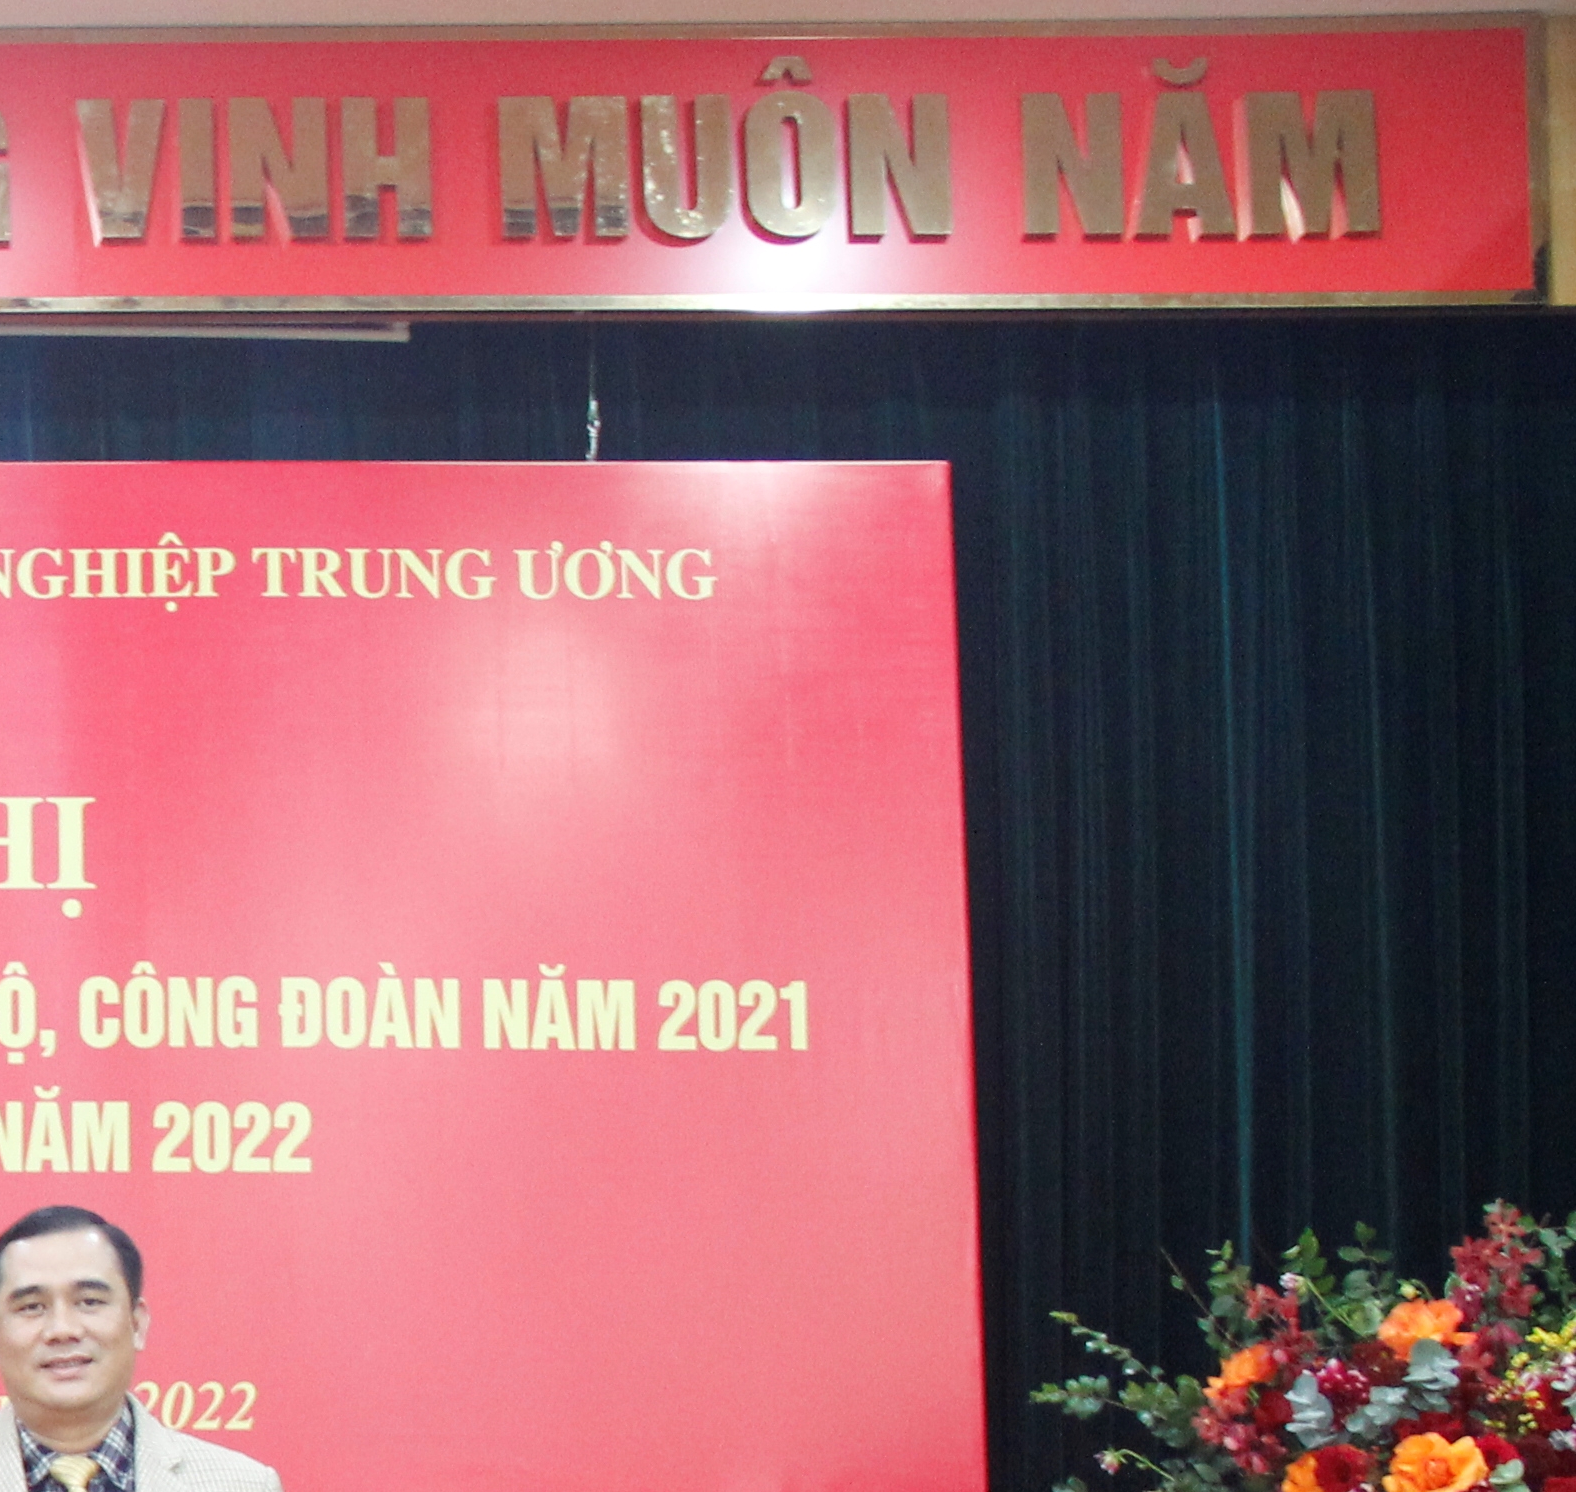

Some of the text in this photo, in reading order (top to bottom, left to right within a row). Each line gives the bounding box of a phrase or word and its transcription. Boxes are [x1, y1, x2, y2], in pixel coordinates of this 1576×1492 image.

[73, 96, 434, 248] VINH
[497, 54, 952, 243] MUÔN
[1019, 55, 1384, 242] NĂM
[251, 548, 496, 600] TRUNG
[514, 541, 717, 601] ƯƠNG
[78, 961, 258, 1049] CÔNG
[277, 963, 460, 1050] ĐOÀN
[482, 964, 636, 1050] NĂM
[657, 978, 808, 1051] 2021
[151, 1100, 312, 1173] 2022
[132, 1381, 258, 1430] 2022
